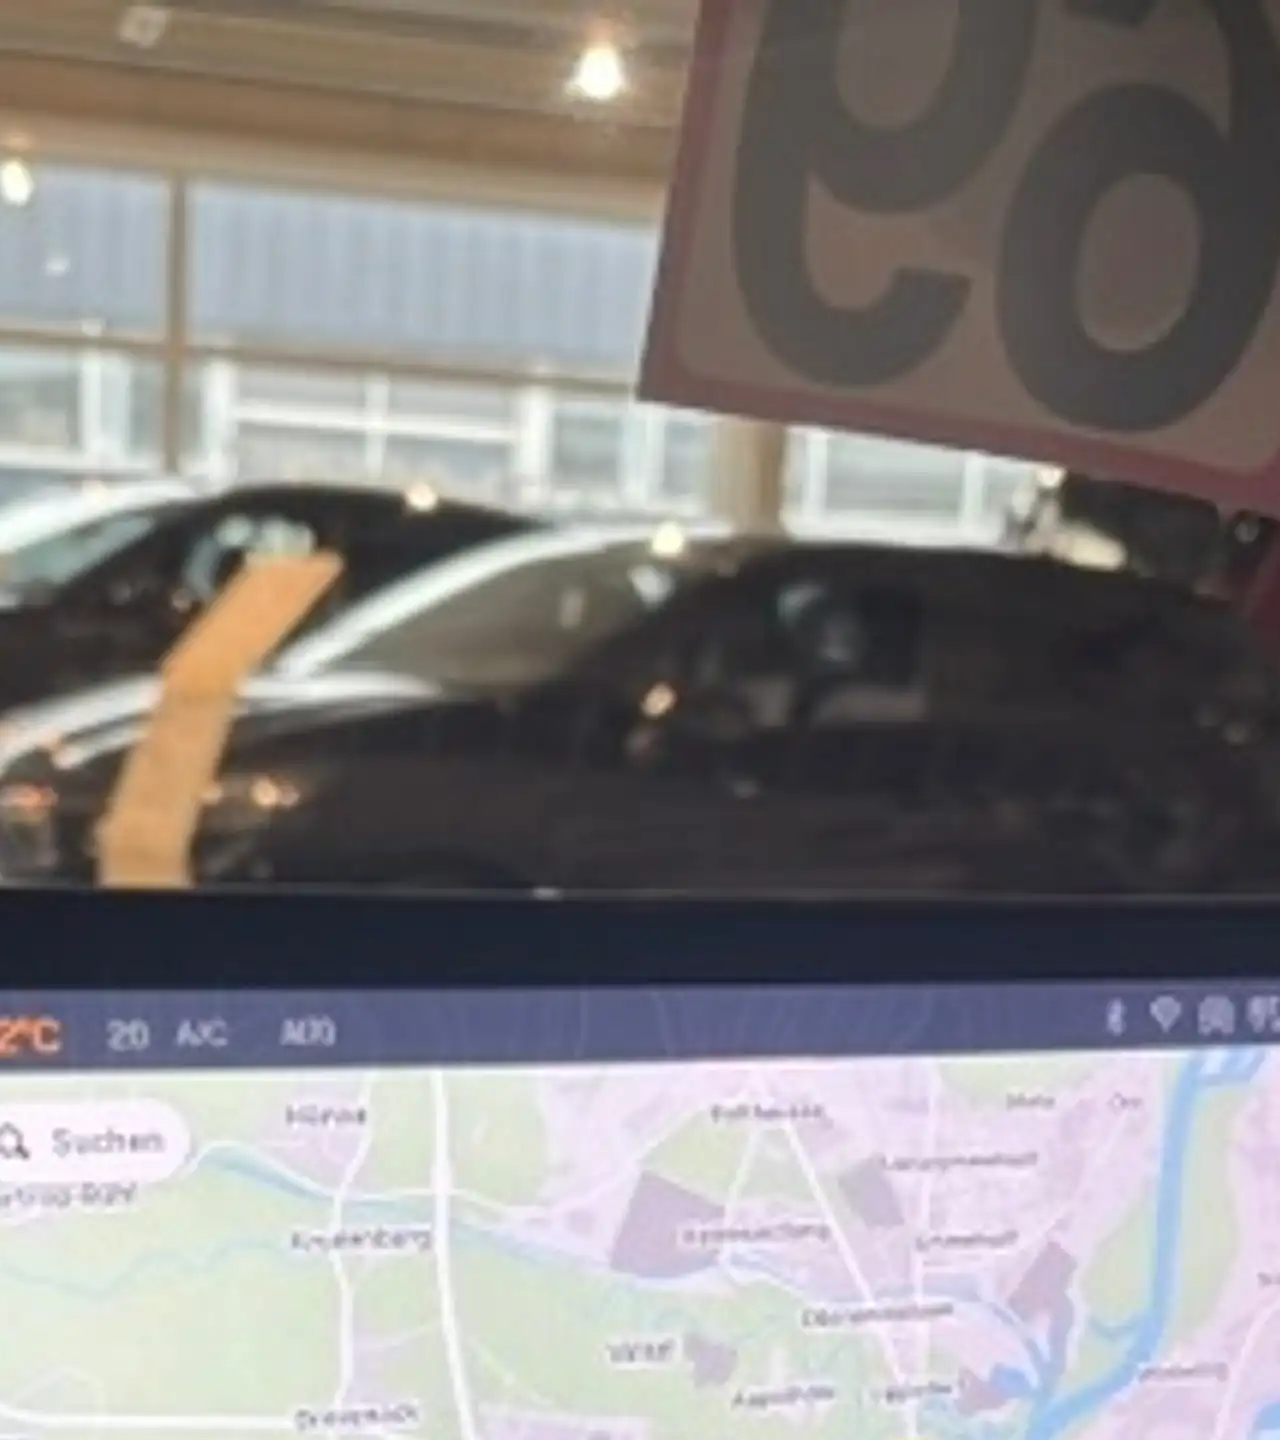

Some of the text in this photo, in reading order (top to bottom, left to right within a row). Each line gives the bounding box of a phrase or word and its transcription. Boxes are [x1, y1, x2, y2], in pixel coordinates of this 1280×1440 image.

[106, 1018, 150, 1052] 20
[175, 1018, 229, 1049] A/C
[52, 1126, 166, 1157] Suchen
